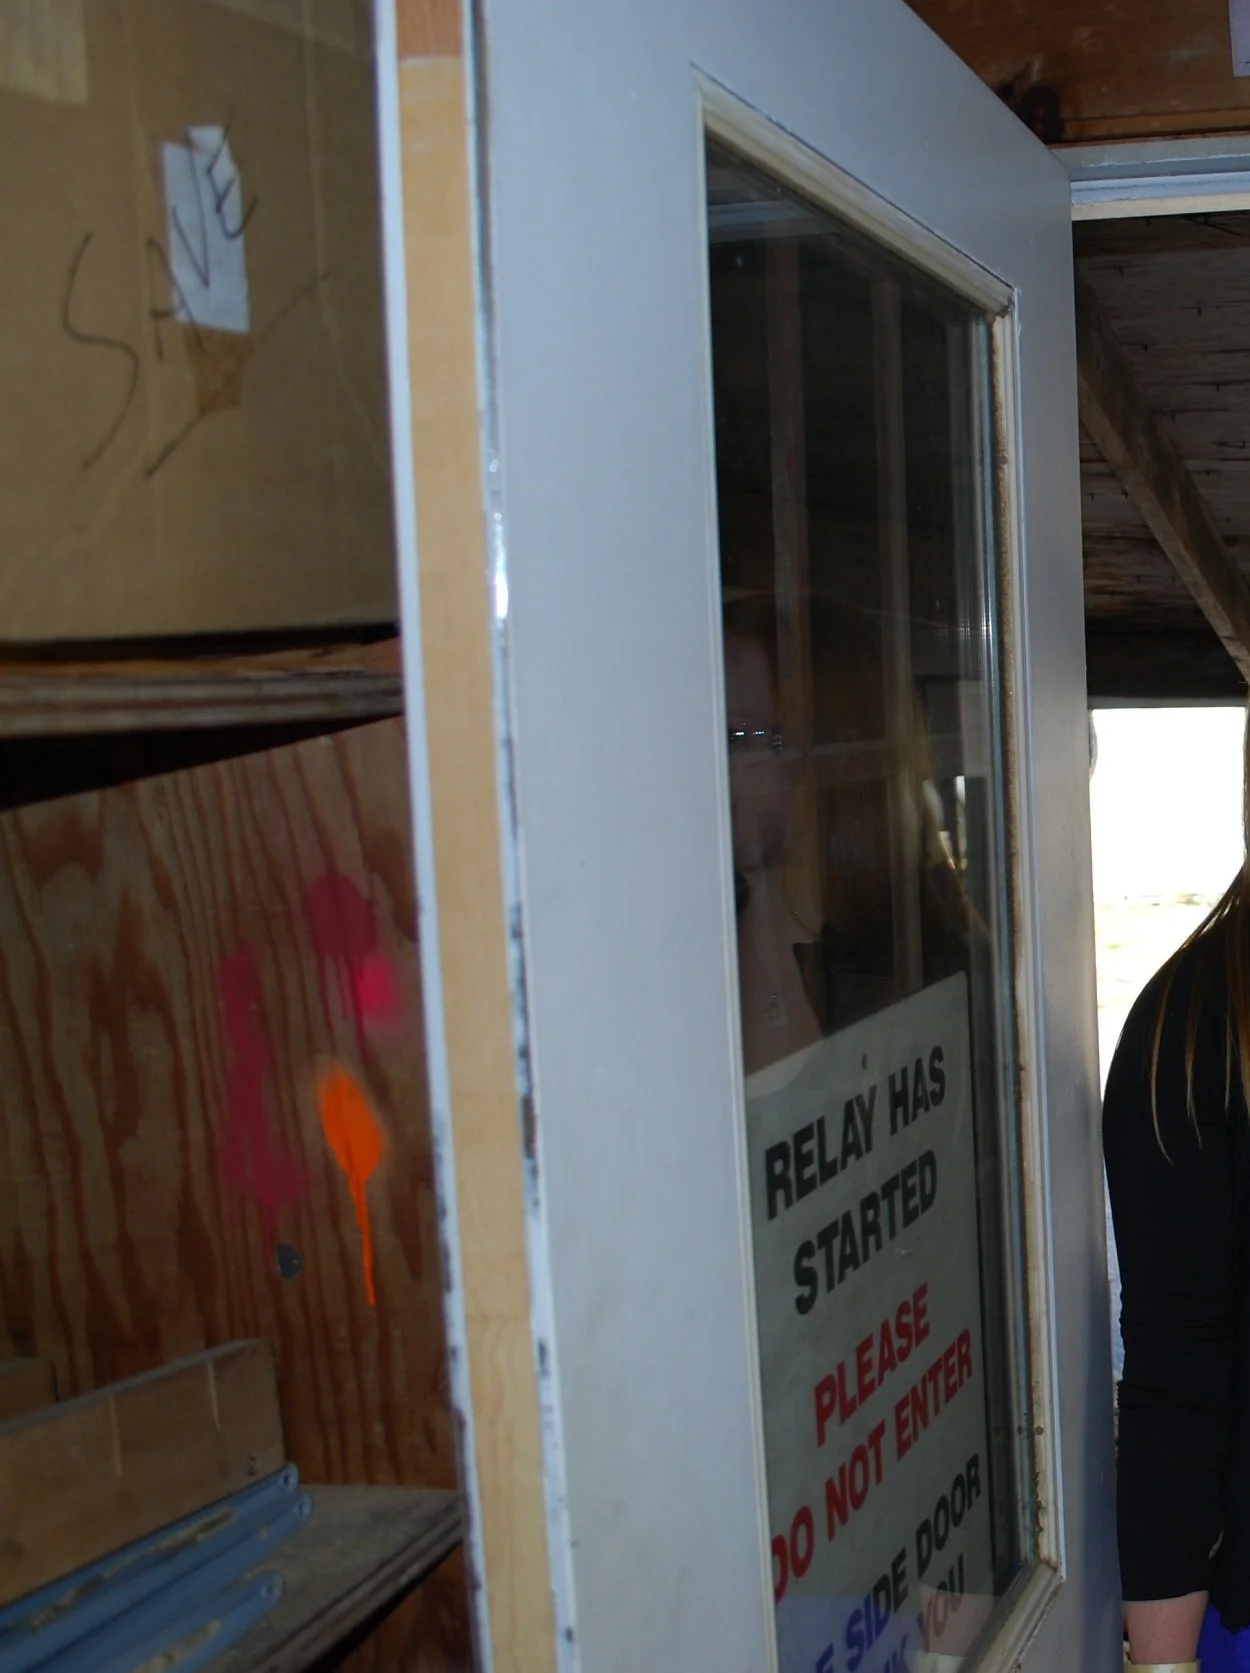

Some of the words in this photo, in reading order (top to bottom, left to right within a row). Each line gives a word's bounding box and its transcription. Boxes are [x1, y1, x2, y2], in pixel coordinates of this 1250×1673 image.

[765, 1083, 878, 1220] RELAY
[889, 1046, 946, 1136] HAS
[794, 1149, 938, 1315] STARTED
[814, 1281, 931, 1448] PLEASE
[825, 1420, 886, 1543] NOT
[896, 1327, 974, 1461] ENTER
[845, 1547, 910, 1672] SIDE
[915, 1452, 982, 1579] DOOR
